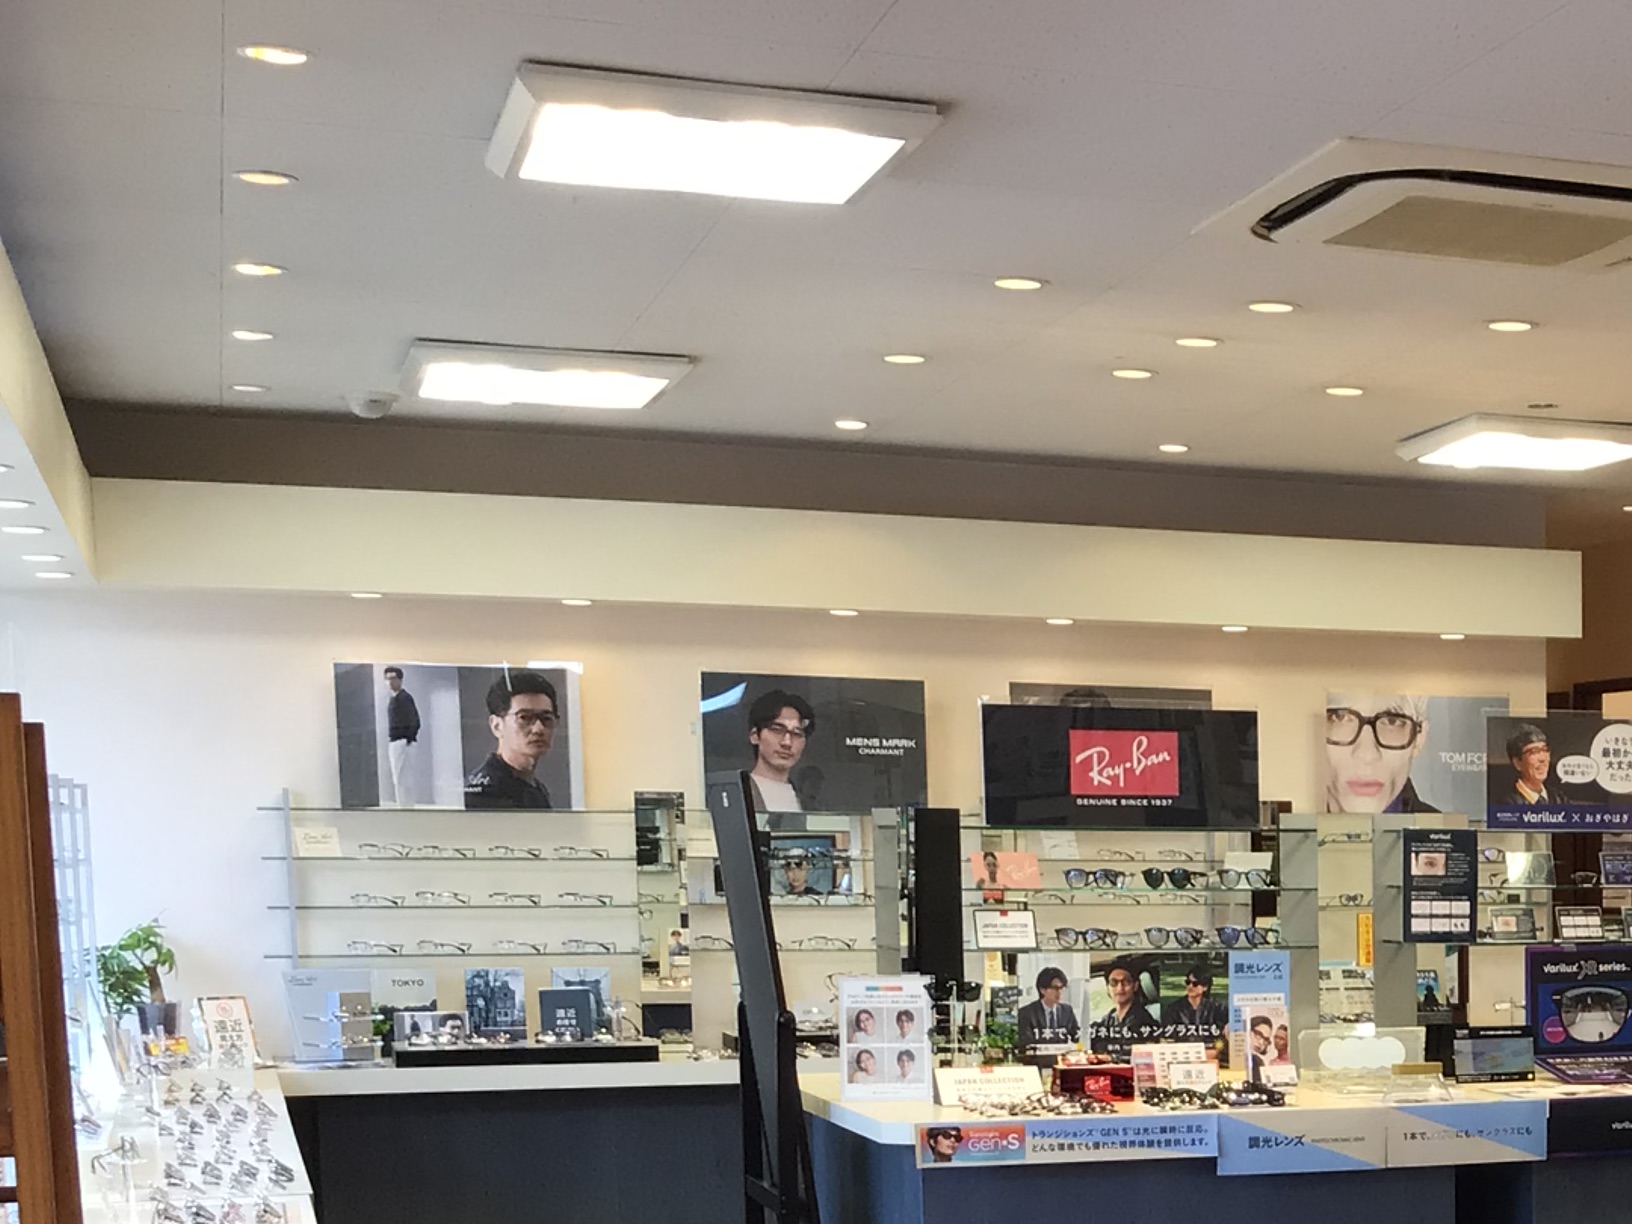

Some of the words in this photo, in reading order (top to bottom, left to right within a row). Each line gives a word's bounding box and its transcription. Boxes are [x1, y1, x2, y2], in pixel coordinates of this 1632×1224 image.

[858, 747, 904, 756] CHARMANT
[1439, 751, 1466, 764] TOM
[1076, 798, 1118, 806] GENUINE
[1120, 798, 1149, 806] SINCE
[1150, 798, 1173, 806] 1937
[1585, 813, 1630, 823] おぎやはぎ
[1233, 962, 1283, 974] 調光レンズ
[391, 979, 424, 987] TOKYO
[1248, 1135, 1305, 1149] 調光レンズ
